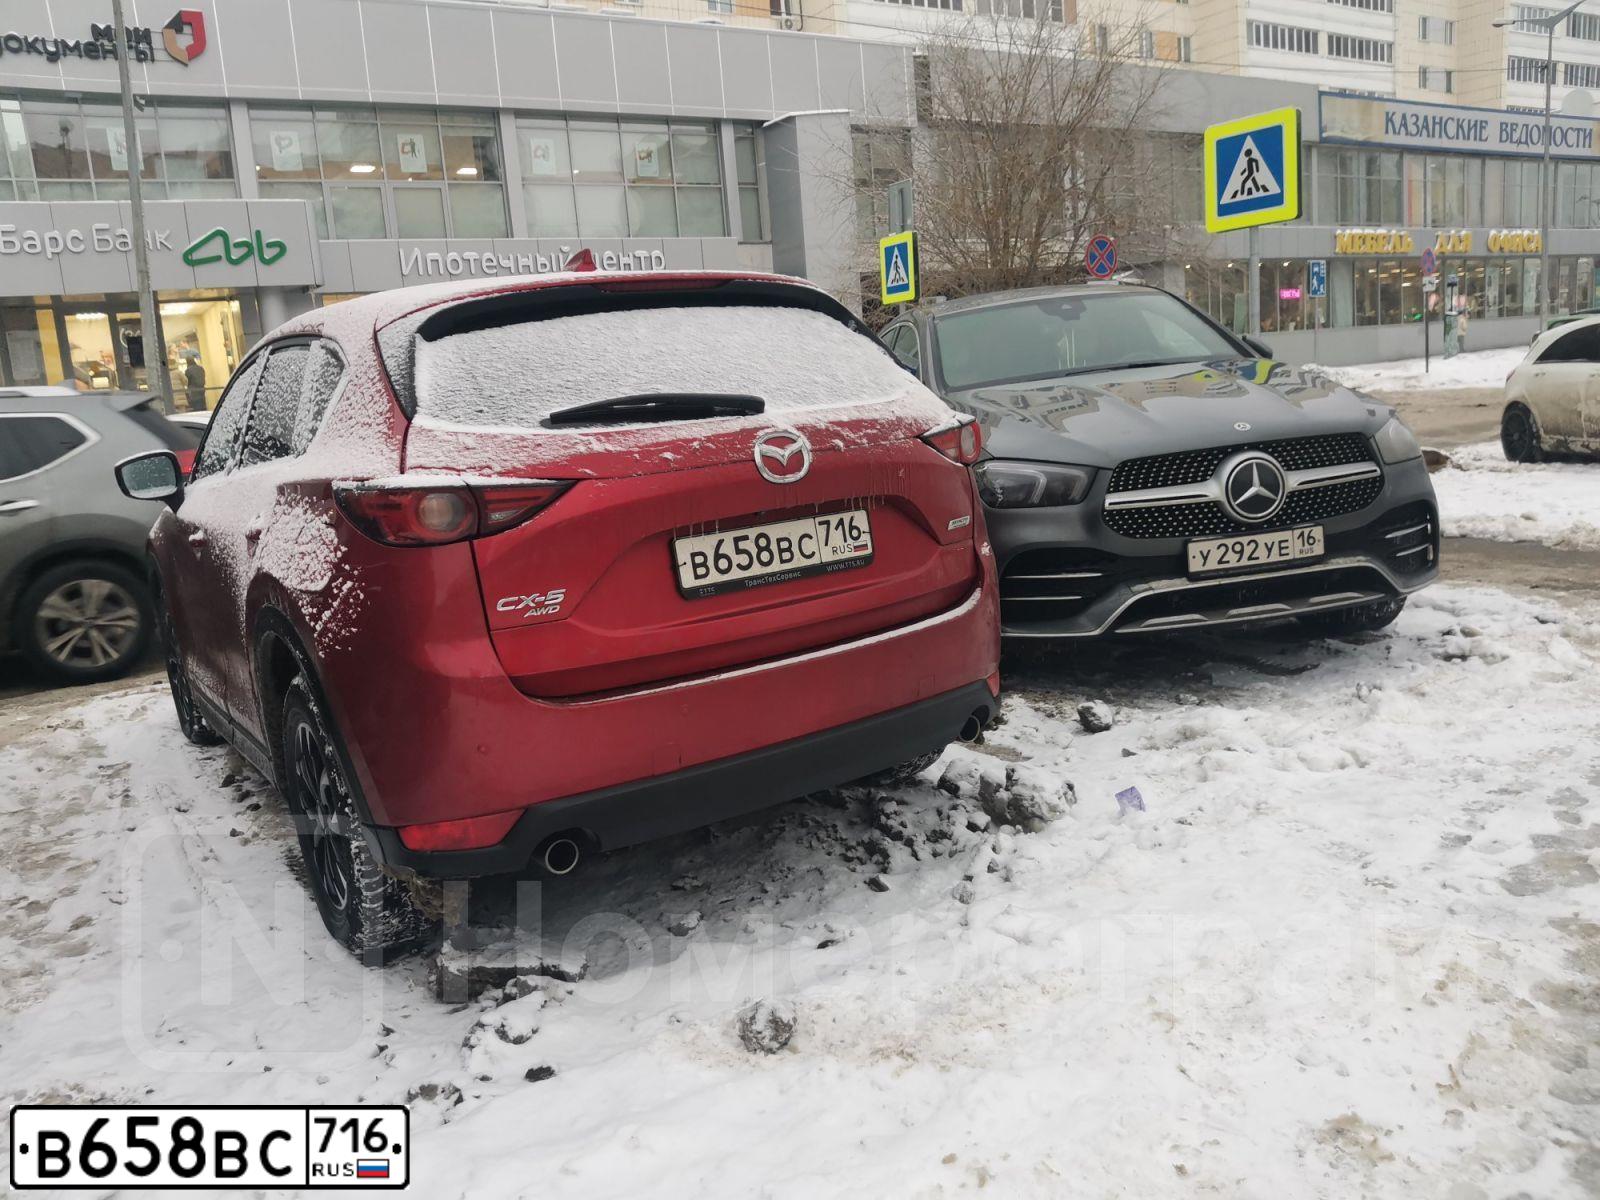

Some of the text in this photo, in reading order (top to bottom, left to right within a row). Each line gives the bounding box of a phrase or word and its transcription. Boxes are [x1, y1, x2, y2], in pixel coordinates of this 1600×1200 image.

[0, 33, 155, 63] окумены
[1385, 111, 1489, 142] КАЗАНСКИЕ
[0, 223, 173, 259] Барс Бак
[1335, 229, 1543, 255] МЕБЕЛЬ ДЛЯ ОФИСА
[593, 250, 666, 271] ентр
[690, 515, 861, 580] В658ВС 716
[832, 543, 852, 556] RUS
[1199, 529, 1316, 567] У292УЕ 16
[744, 571, 801, 587] ТрансТехСервис
[496, 588, 567, 612] CX-5
[523, 605, 560, 618] AWD
